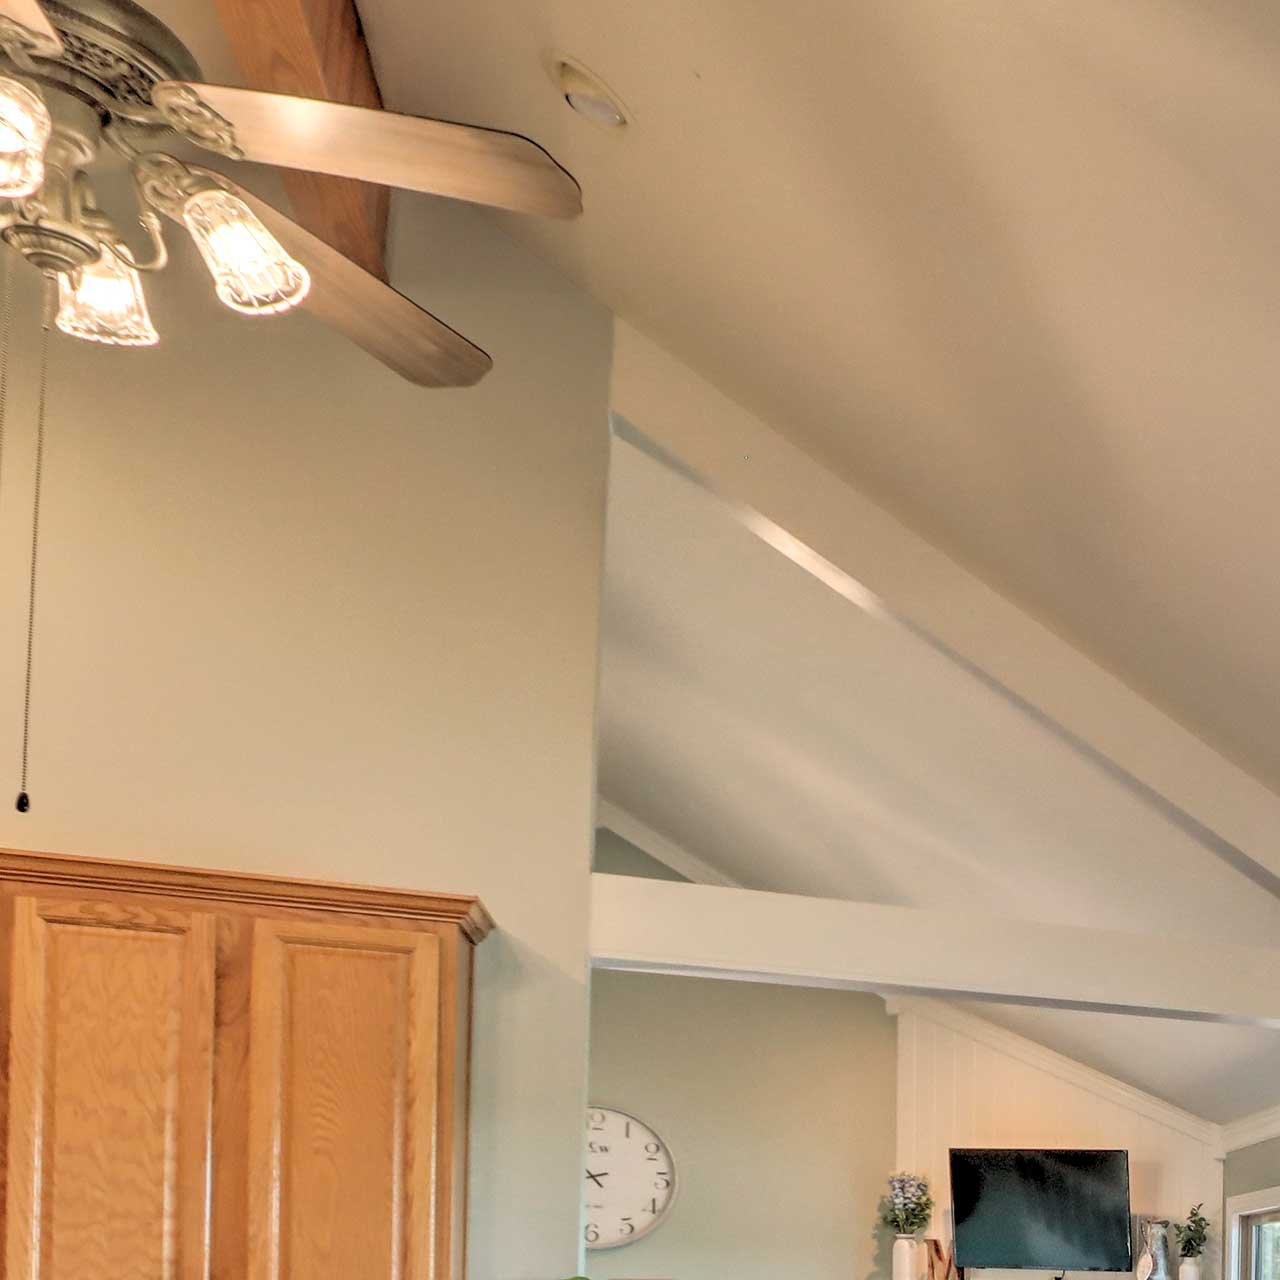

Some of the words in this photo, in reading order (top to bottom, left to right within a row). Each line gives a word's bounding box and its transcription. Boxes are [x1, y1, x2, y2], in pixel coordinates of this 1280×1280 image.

[644, 1142, 660, 1161] 2
[654, 1171, 671, 1191] 3
[641, 1198, 662, 1215] 4
[585, 1224, 600, 1243] 6
[619, 1217, 635, 1236] 5
